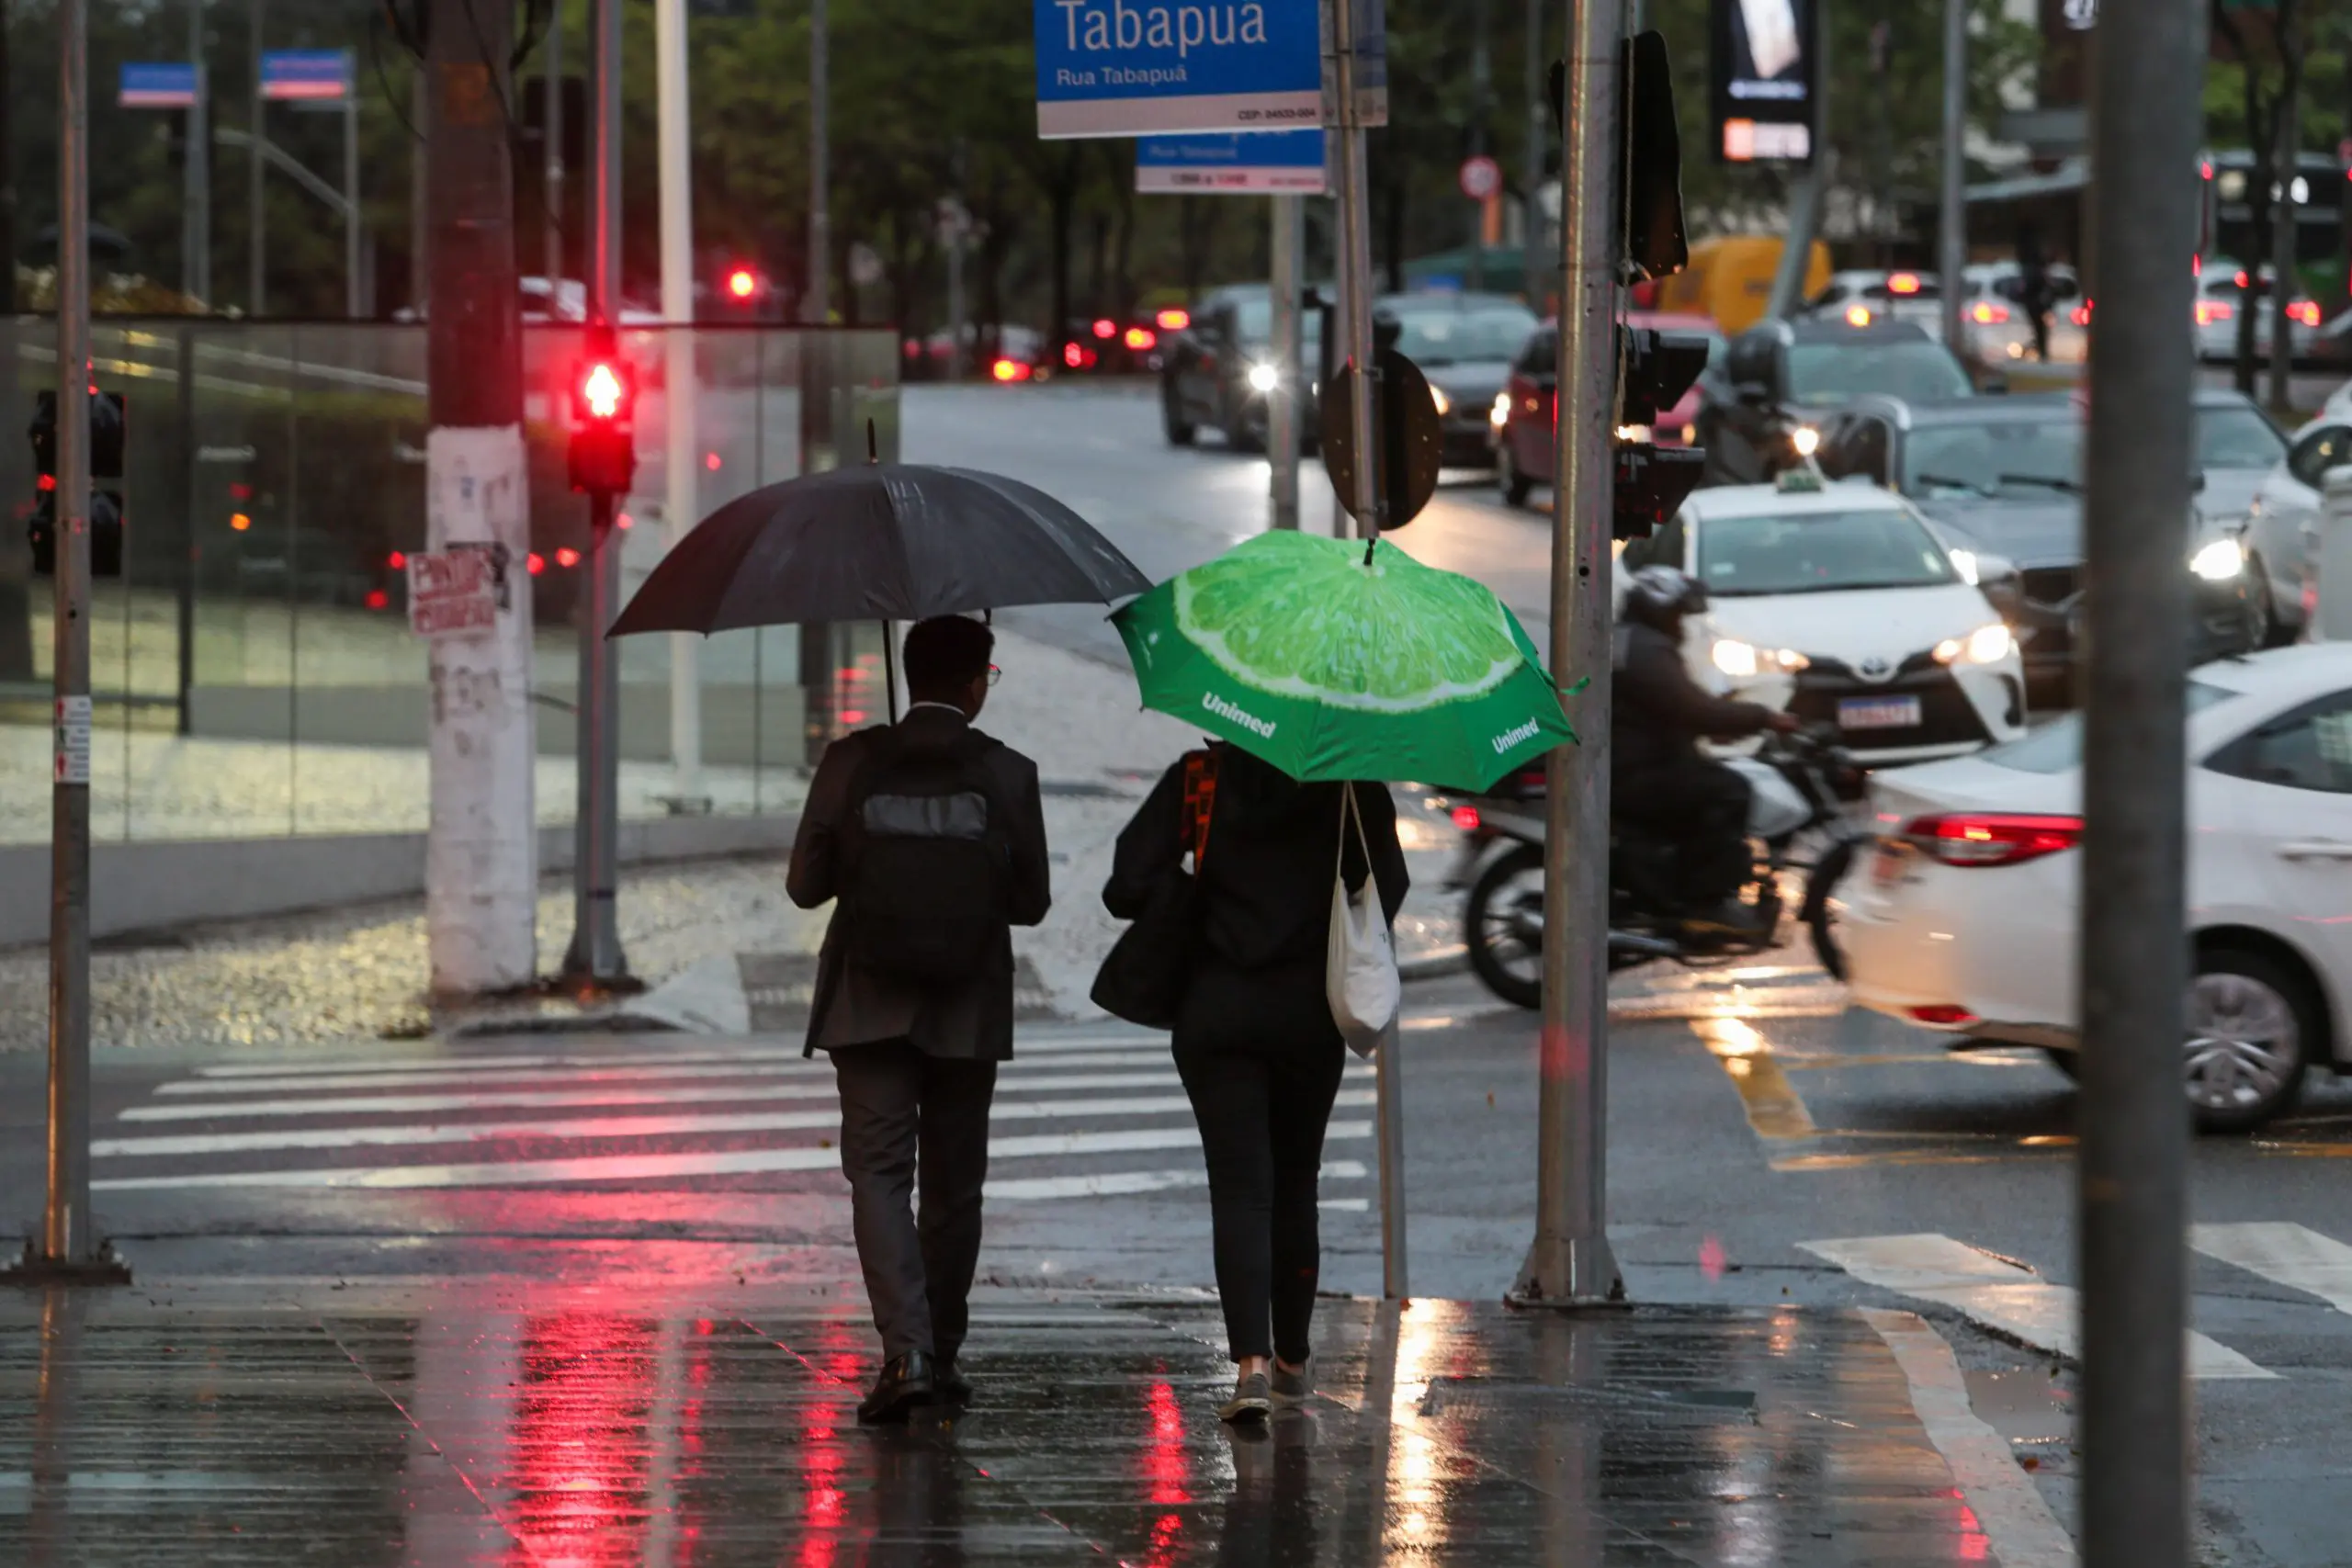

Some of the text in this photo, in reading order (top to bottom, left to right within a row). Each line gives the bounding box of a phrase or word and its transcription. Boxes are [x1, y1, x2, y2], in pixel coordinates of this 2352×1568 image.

[1057, 69, 1095, 85] Rua
[1202, 691, 1276, 739] Unimed
[1492, 716, 1540, 754] Unimed
